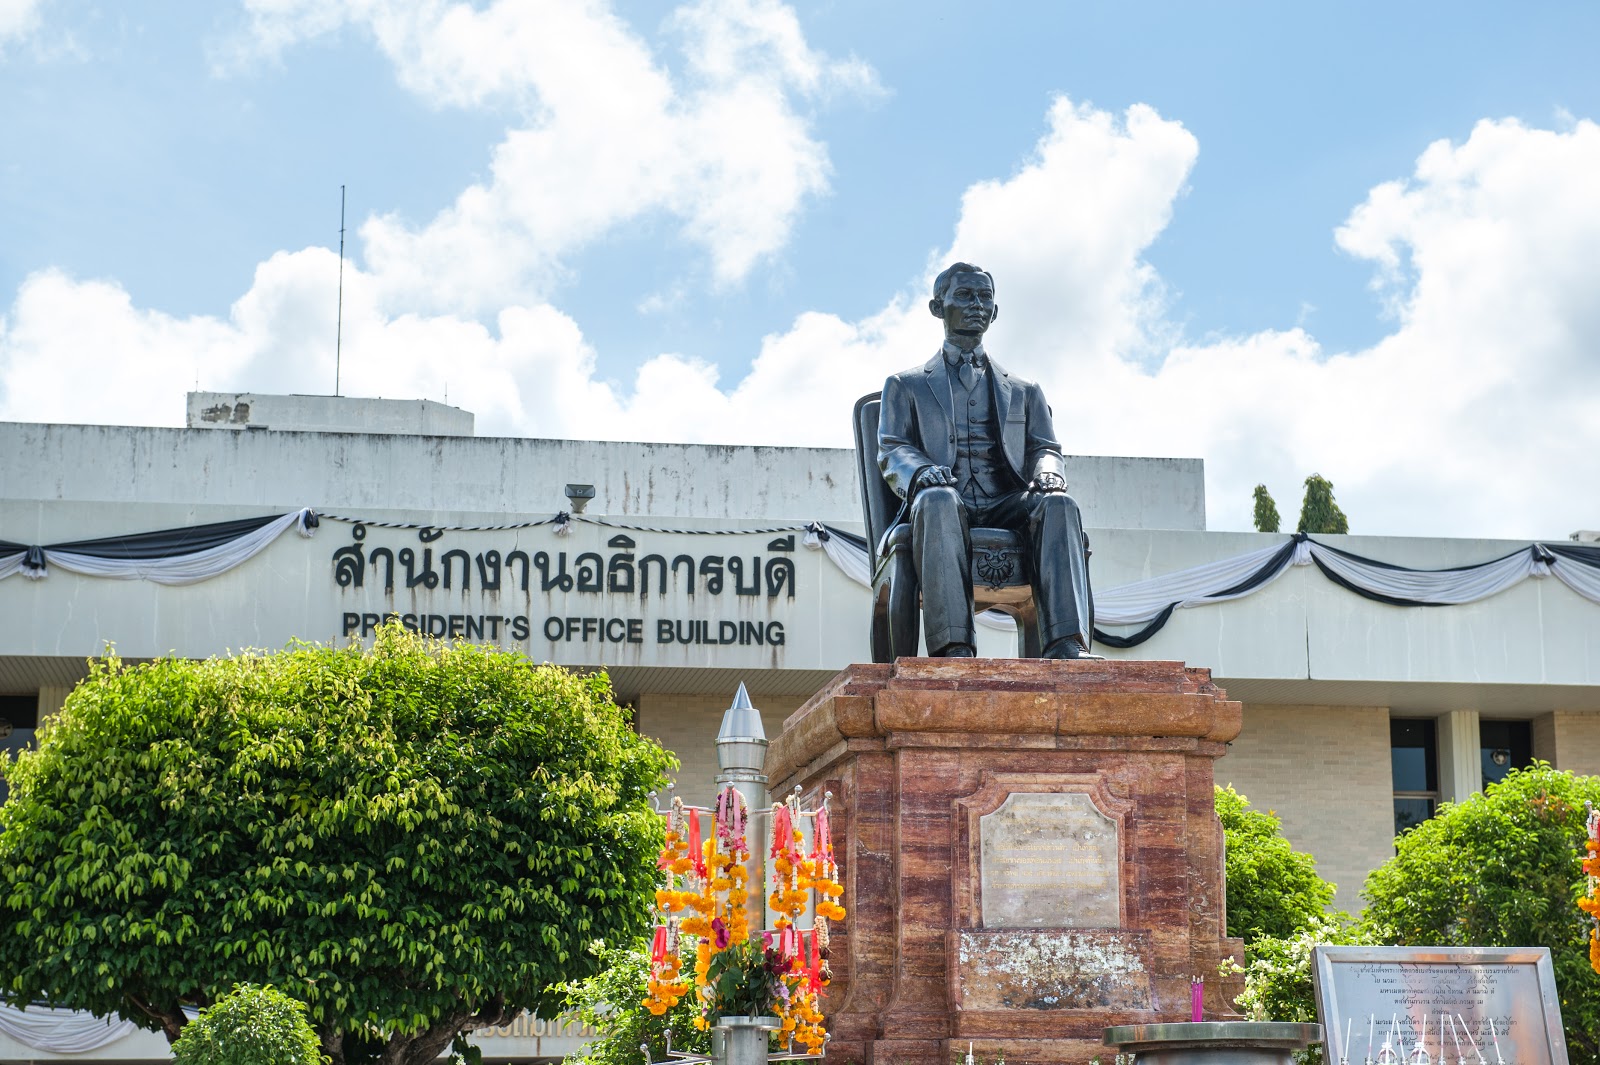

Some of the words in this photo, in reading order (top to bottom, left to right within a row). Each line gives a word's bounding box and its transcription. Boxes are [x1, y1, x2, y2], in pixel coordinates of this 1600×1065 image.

[333, 523, 795, 597] สำนักงานอธิการบดี
[543, 616, 643, 643] OFFICE
[657, 619, 785, 645] BUILDING
